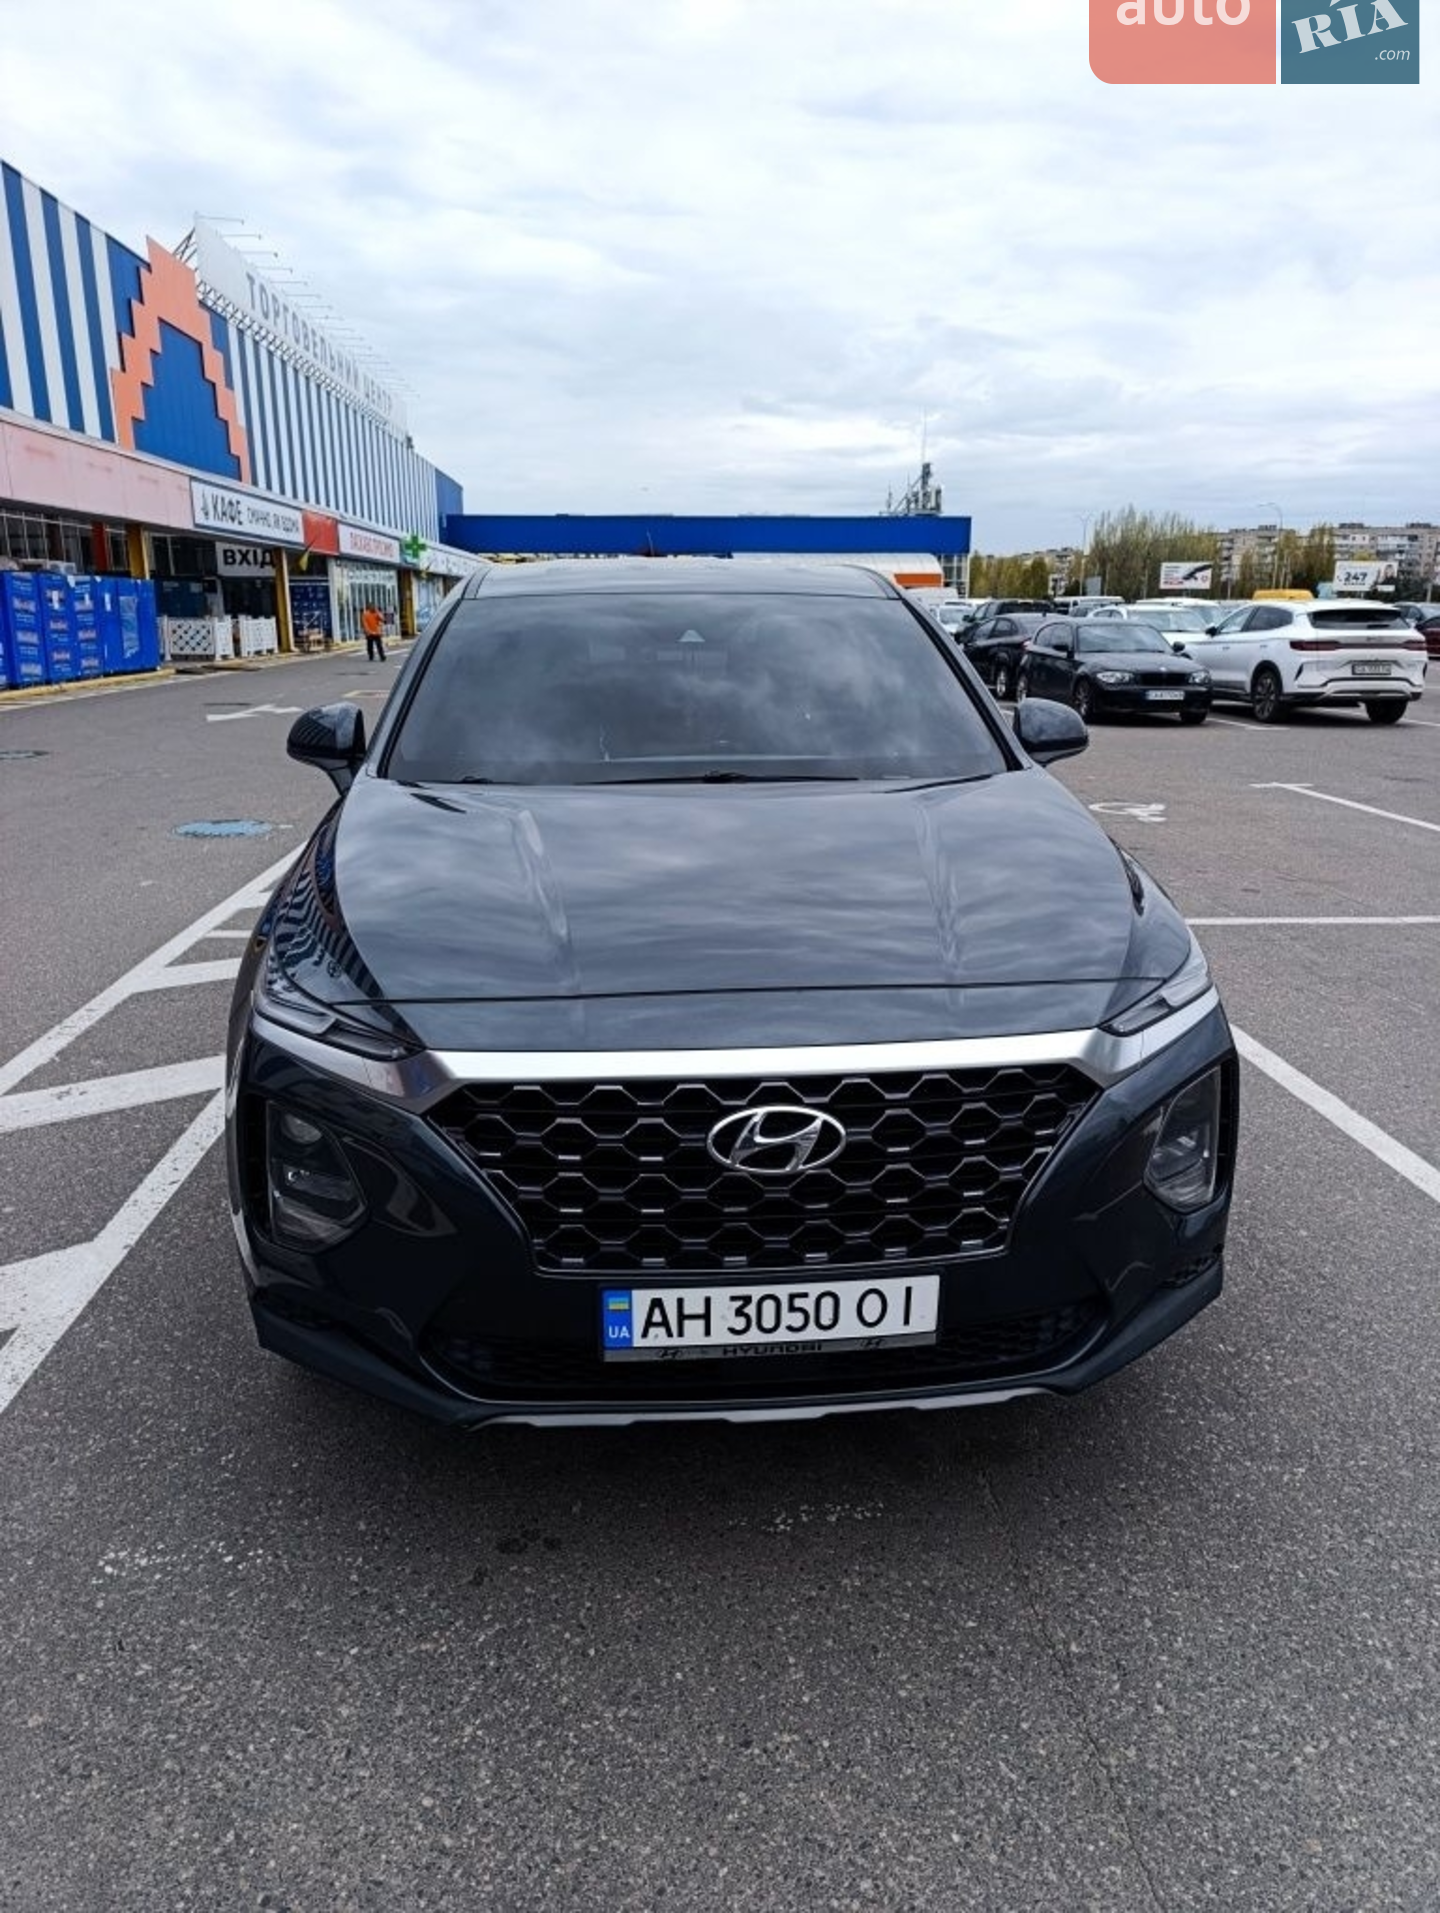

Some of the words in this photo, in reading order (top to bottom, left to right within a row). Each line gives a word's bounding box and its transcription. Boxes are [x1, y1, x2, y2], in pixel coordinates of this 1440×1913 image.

[211, 492, 243, 525] КАФЕ
[223, 548, 276, 568] ВХІД
[641, 1296, 711, 1339] AH
[727, 1290, 840, 1334] 3050
[608, 1326, 630, 1338] UA
